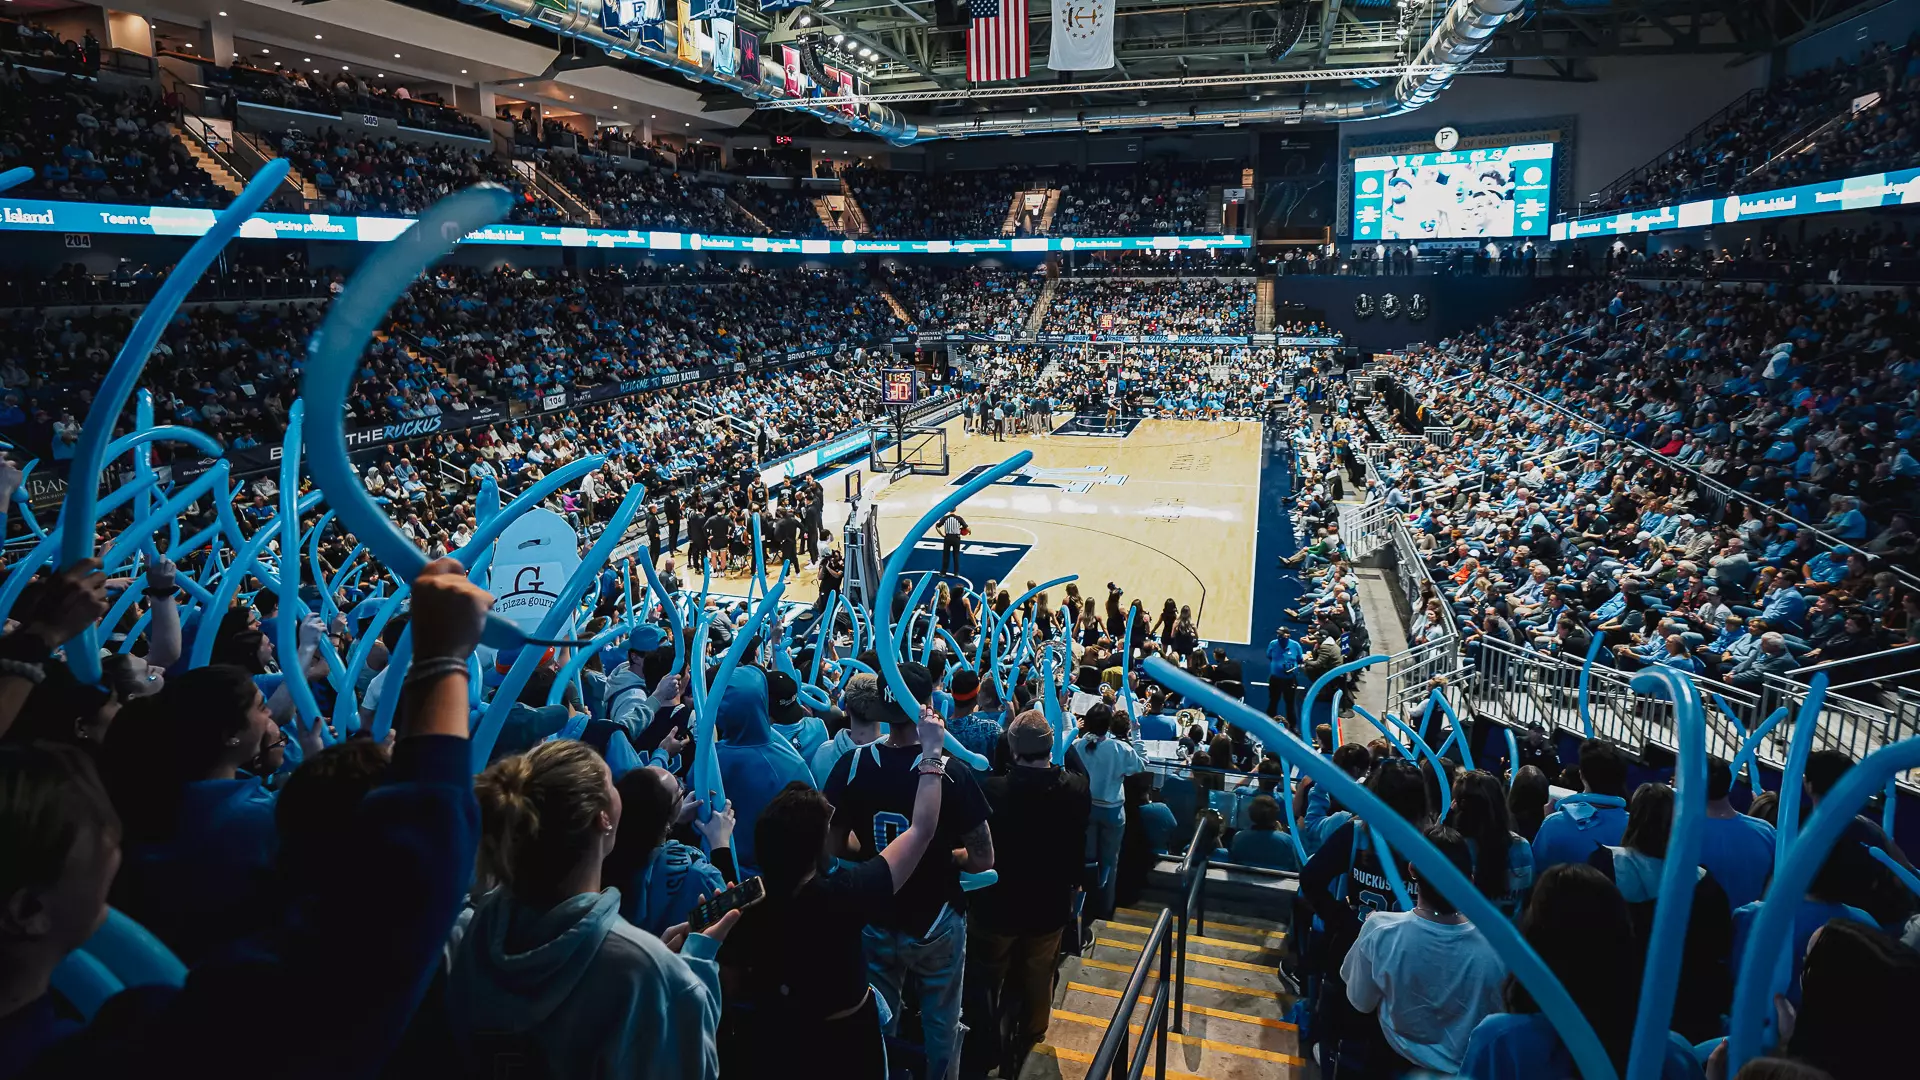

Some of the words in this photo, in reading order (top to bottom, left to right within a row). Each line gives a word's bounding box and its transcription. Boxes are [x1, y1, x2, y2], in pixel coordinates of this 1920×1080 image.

[364, 115, 378, 126] 305
[4, 207, 55, 225] Island
[100, 211, 137, 226] Team
[65, 234, 90, 247] 204
[787, 350, 805, 361] BRING
[806, 349, 817, 359] THE
[620, 379, 650, 394] WELCOME
[680, 369, 700, 382] NATION
[889, 383, 908, 400] 30
[345, 428, 384, 446] THE
[383, 415, 442, 440] RUCKUS
[33, 478, 69, 496] BAN
[514, 566, 545, 593] G
[502, 597, 527, 613] pizza
[665, 846, 690, 897] ISLAN
[1353, 867, 1392, 892] RUCKUS
